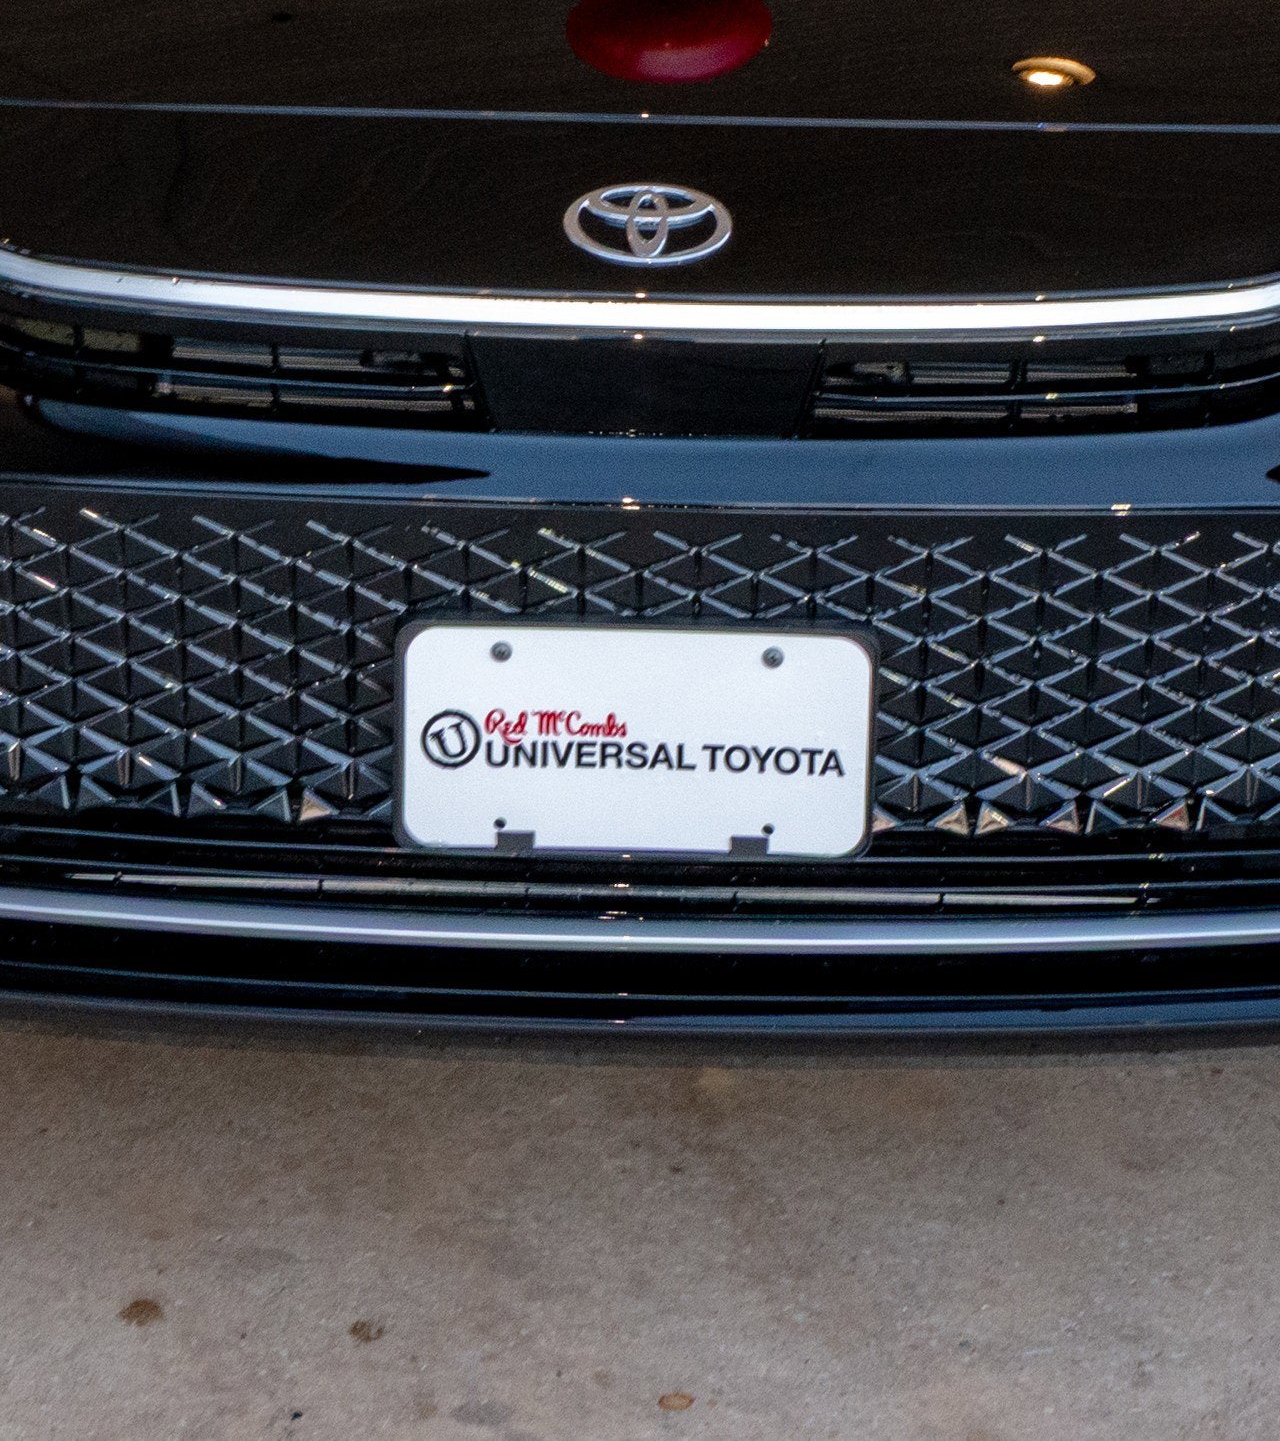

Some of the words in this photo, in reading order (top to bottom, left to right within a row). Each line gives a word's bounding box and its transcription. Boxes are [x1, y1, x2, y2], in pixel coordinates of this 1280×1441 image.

[484, 708, 529, 745] Red
[532, 709, 628, 739] McCombs
[485, 740, 697, 771] UNIVERSAL
[702, 744, 845, 777] TOYOTA
